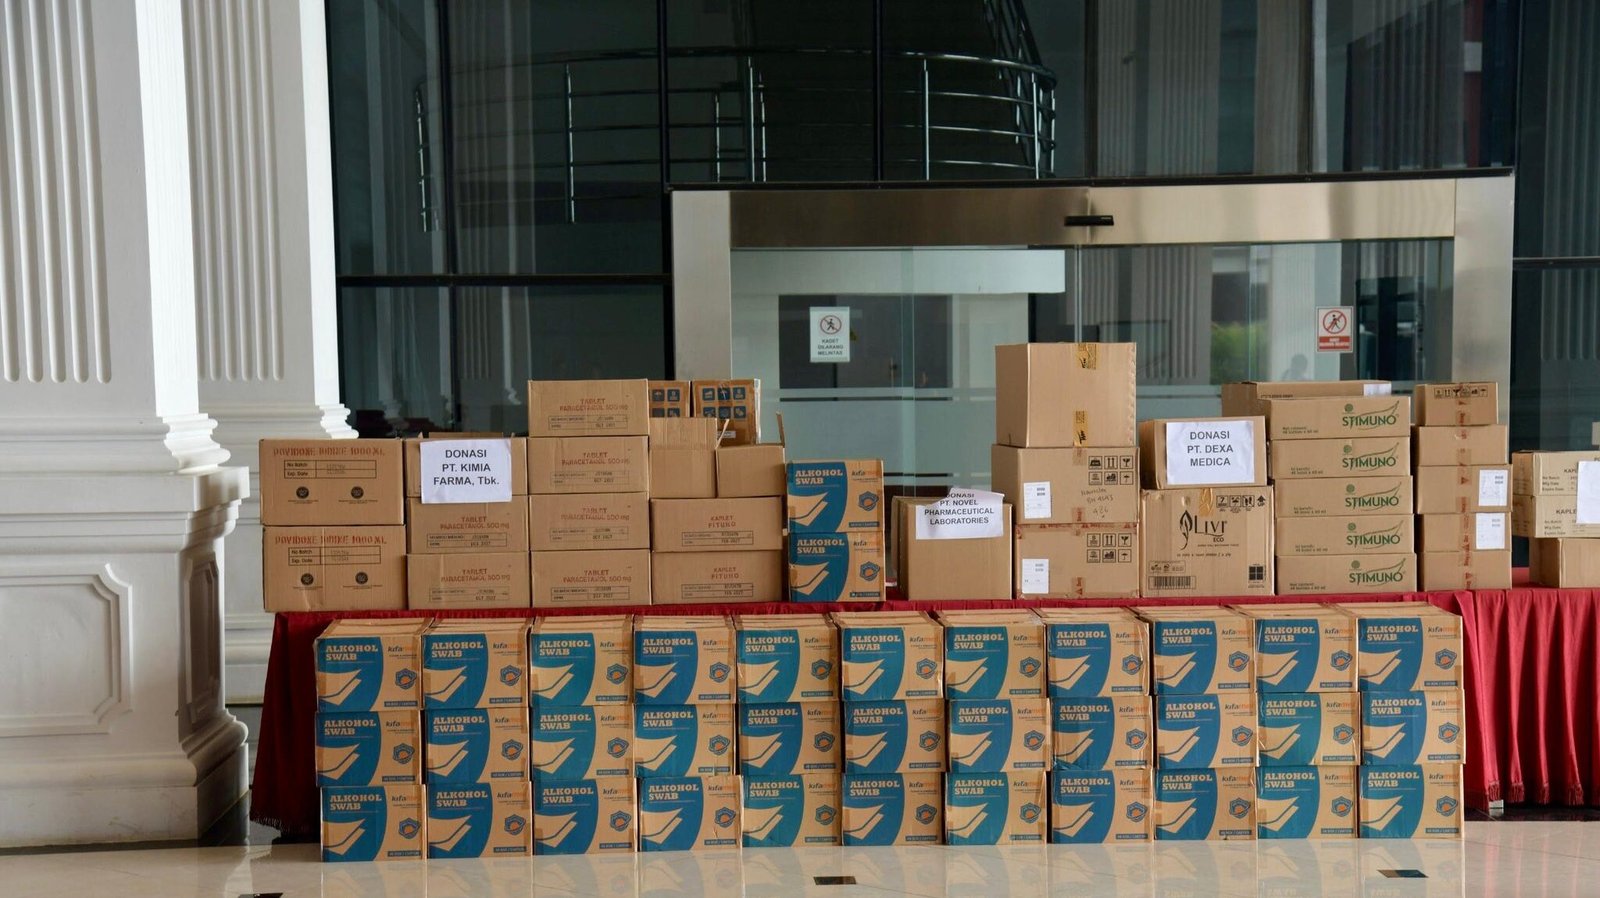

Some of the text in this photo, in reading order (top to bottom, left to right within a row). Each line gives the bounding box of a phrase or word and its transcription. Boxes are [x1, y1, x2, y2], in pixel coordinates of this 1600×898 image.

[1342, 415, 1396, 429] STIMUNO
[1190, 431, 1230, 440] DONASI
[445, 449, 487, 458] DONASI
[1187, 445, 1234, 454] PT. DEXA
[1190, 458, 1231, 467] MEDICA
[1342, 456, 1396, 470] STIMUNO
[442, 463, 491, 472] PT. KIMIA
[795, 469, 843, 477] ALKOHOL
[434, 476, 500, 486] FARMA, Tbk.
[795, 477, 824, 485] SWAB
[1345, 496, 1399, 509] STIMUNO
[930, 517, 989, 525] LABORATORIES
[1346, 534, 1400, 548] STIMUNO
[1349, 572, 1403, 585] STIMUNO
[1162, 628, 1212, 636] ALKOHOL
[1264, 626, 1315, 635] ALKOHOL
[1367, 625, 1418, 634] ALKOHOL
[851, 635, 901, 643] ALKOHOL
[954, 634, 1004, 642] ALKOHOL
[1056, 631, 1107, 639] ALKOHOL
[1264, 634, 1295, 642] SWAB
[1367, 633, 1397, 641] SWAB
[745, 636, 796, 645] ALKOHOL
[1056, 639, 1087, 647] SWAB
[1162, 636, 1193, 644] SWAB
[432, 642, 483, 650] ALKOHOL
[745, 644, 776, 653] SWAB
[851, 643, 881, 651] SWAB
[954, 641, 984, 650] SWAB
[1166, 702, 1216, 712] ALKOHOL
[1266, 700, 1317, 708] ALKOHOL
[1371, 698, 1423, 707] ALKOHOL
[748, 709, 798, 717] ALKOHOL
[853, 708, 904, 716] ALKOHOL
[958, 707, 1009, 716] ALKOHOL
[1166, 710, 1196, 719] SWAB
[1266, 708, 1296, 716] SWAB
[1371, 706, 1401, 715] SWAB
[433, 716, 485, 724] ALKOHOL
[540, 714, 591, 722] ALKOHOL
[643, 711, 694, 720] ALKOHOL
[958, 715, 989, 723] SWAB
[433, 724, 464, 732] SWAB
[540, 722, 571, 730] SWAB
[1162, 774, 1212, 783] ALKOHOL
[1264, 772, 1315, 781] ALKOHOL
[1368, 771, 1420, 780] ALKOHOL
[750, 782, 800, 790] ALKOHOL
[954, 779, 1004, 788] ALKOHOL
[1060, 778, 1111, 786] ALKOHOL
[1264, 780, 1295, 788] SWAB
[1368, 779, 1398, 788] SWAB
[543, 787, 594, 796] ALKOHOL
[648, 784, 699, 793] ALKOHOL
[954, 787, 985, 795] SWAB
[330, 794, 382, 802] ALKOHOL
[648, 792, 679, 801] SWAB
